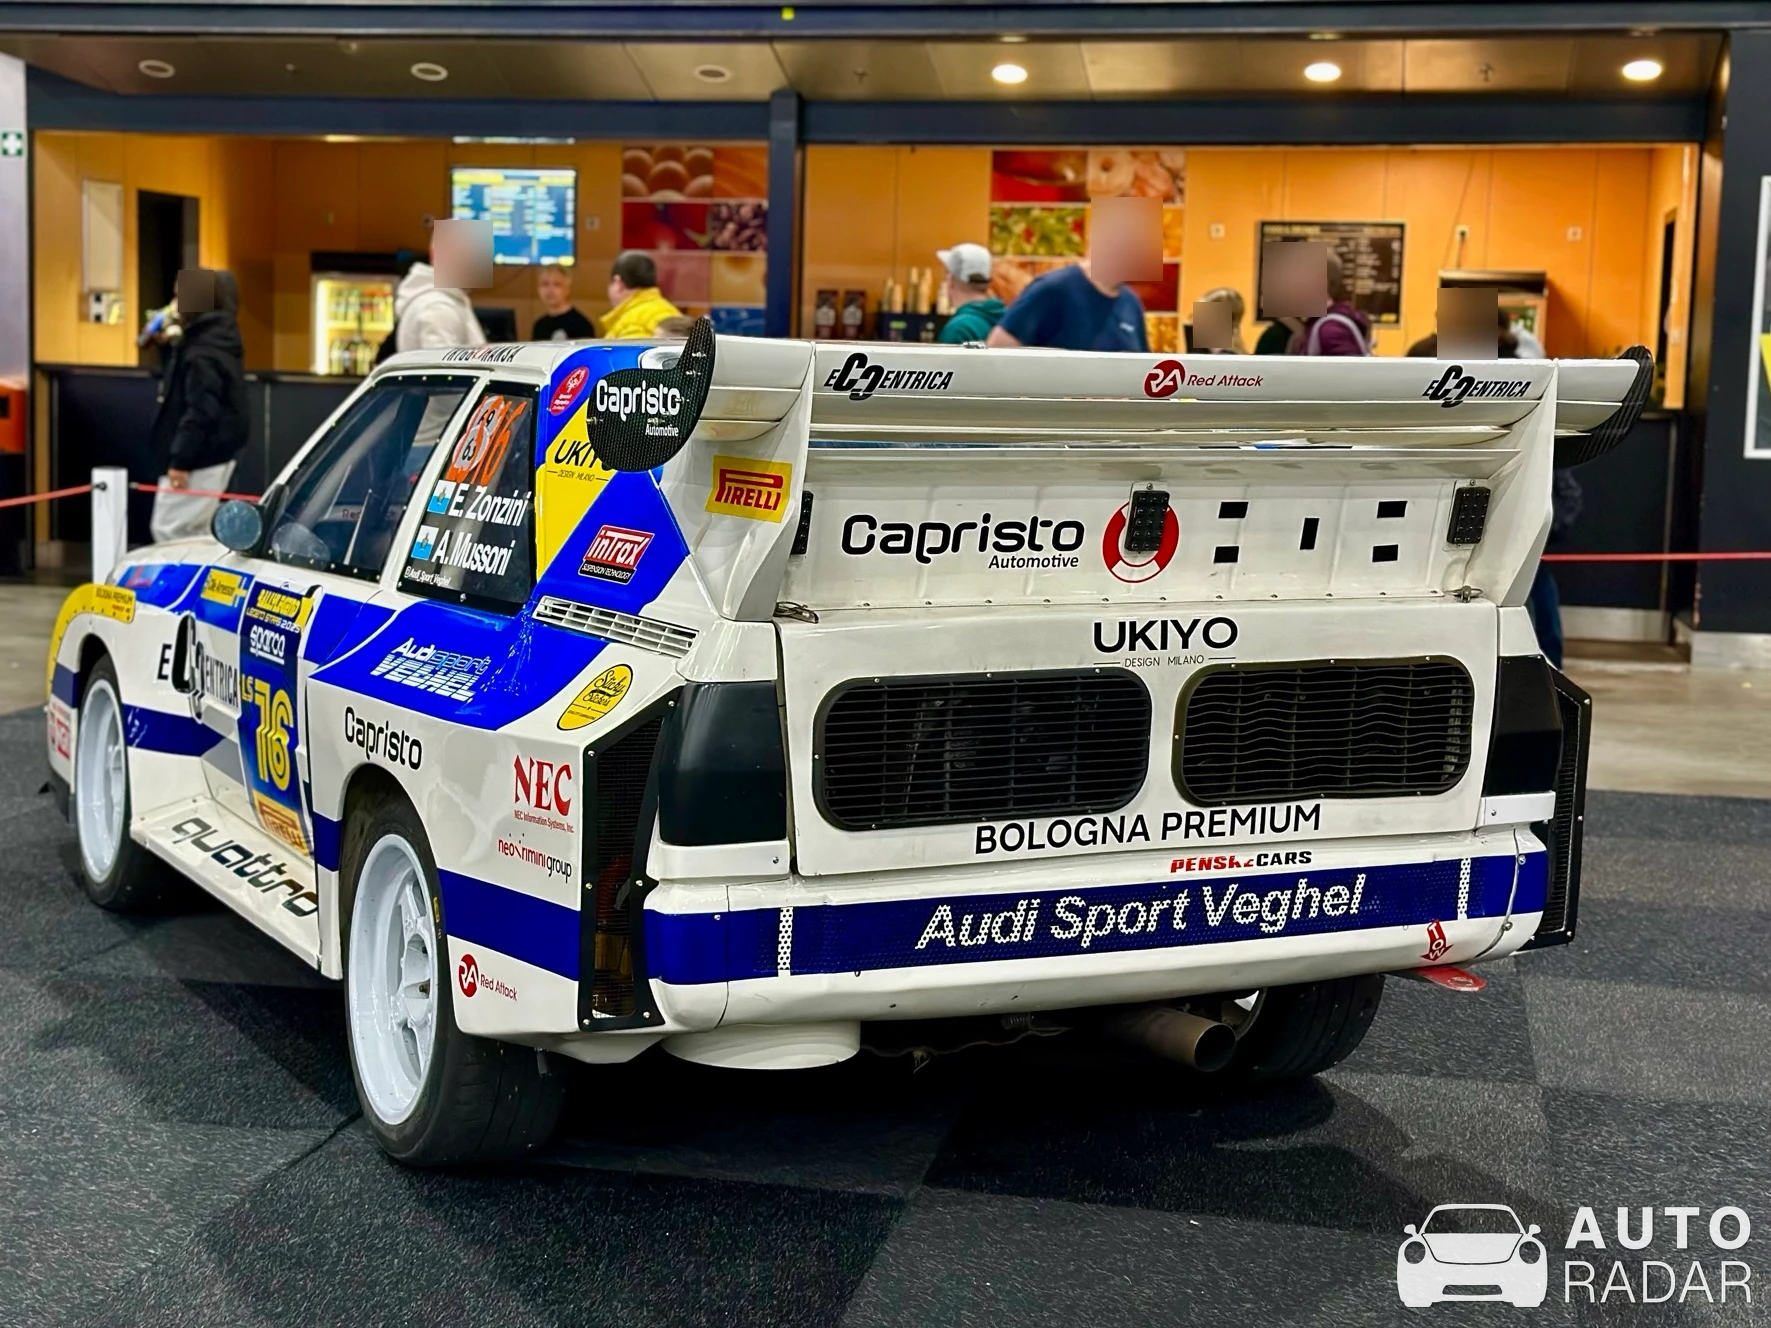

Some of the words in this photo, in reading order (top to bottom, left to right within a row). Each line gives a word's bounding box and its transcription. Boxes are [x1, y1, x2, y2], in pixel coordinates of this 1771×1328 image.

[596, 379, 680, 421] Capristo
[1187, 374, 1216, 387] Red
[1217, 375, 1264, 387] Attack
[645, 424, 679, 437] Automotive
[554, 439, 613, 472] UKIY
[557, 469, 576, 480] DESIGN
[576, 471, 596, 483] MILANO
[714, 468, 783, 512] PIRELLI
[448, 483, 469, 518] E.
[465, 485, 532, 527] Zonzini
[431, 529, 451, 565] A.
[449, 530, 516, 577] Mussoni
[841, 513, 1085, 564] Capristo
[988, 553, 1079, 569] Automotive
[249, 624, 286, 658] sparco
[1094, 617, 1238, 653] UKIYO
[1124, 657, 1160, 668] DESIGN
[1167, 655, 1204, 666] MILANO
[242, 674, 254, 702] LS
[254, 678, 294, 791] 76
[345, 706, 422, 770] Capristo
[514, 755, 572, 816] NEC
[514, 809, 523, 820] NEC
[523, 812, 548, 826] Information
[566, 822, 575, 834] Inc.
[974, 814, 1149, 855] BOLOGNA
[1161, 803, 1321, 842] PREMIUM
[172, 817, 318, 917] quattro
[915, 898, 1041, 950] Audi
[1049, 889, 1190, 949] Sport
[1202, 872, 1367, 935] Veghel
[1428, 922, 1446, 960] TOW
[480, 973, 494, 992] Red
[495, 979, 518, 1001] Attack
